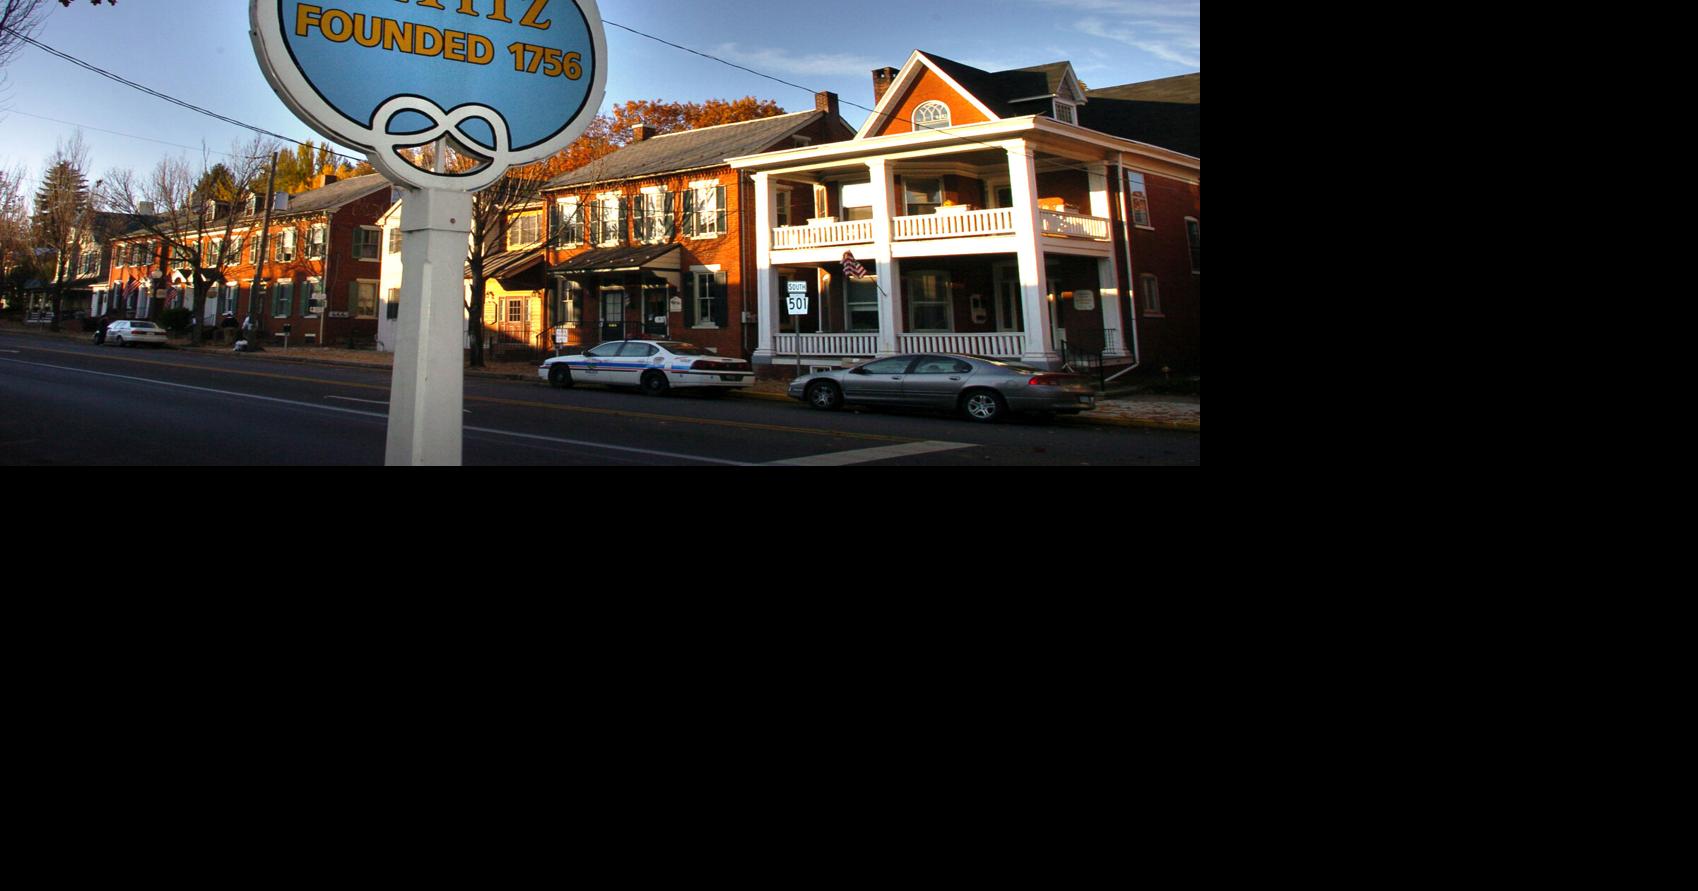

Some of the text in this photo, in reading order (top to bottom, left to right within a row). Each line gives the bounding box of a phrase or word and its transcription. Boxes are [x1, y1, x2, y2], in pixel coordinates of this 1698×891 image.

[295, 3, 495, 65] FOUNDED
[507, 42, 583, 81] 1756
[789, 298, 807, 309] 501
